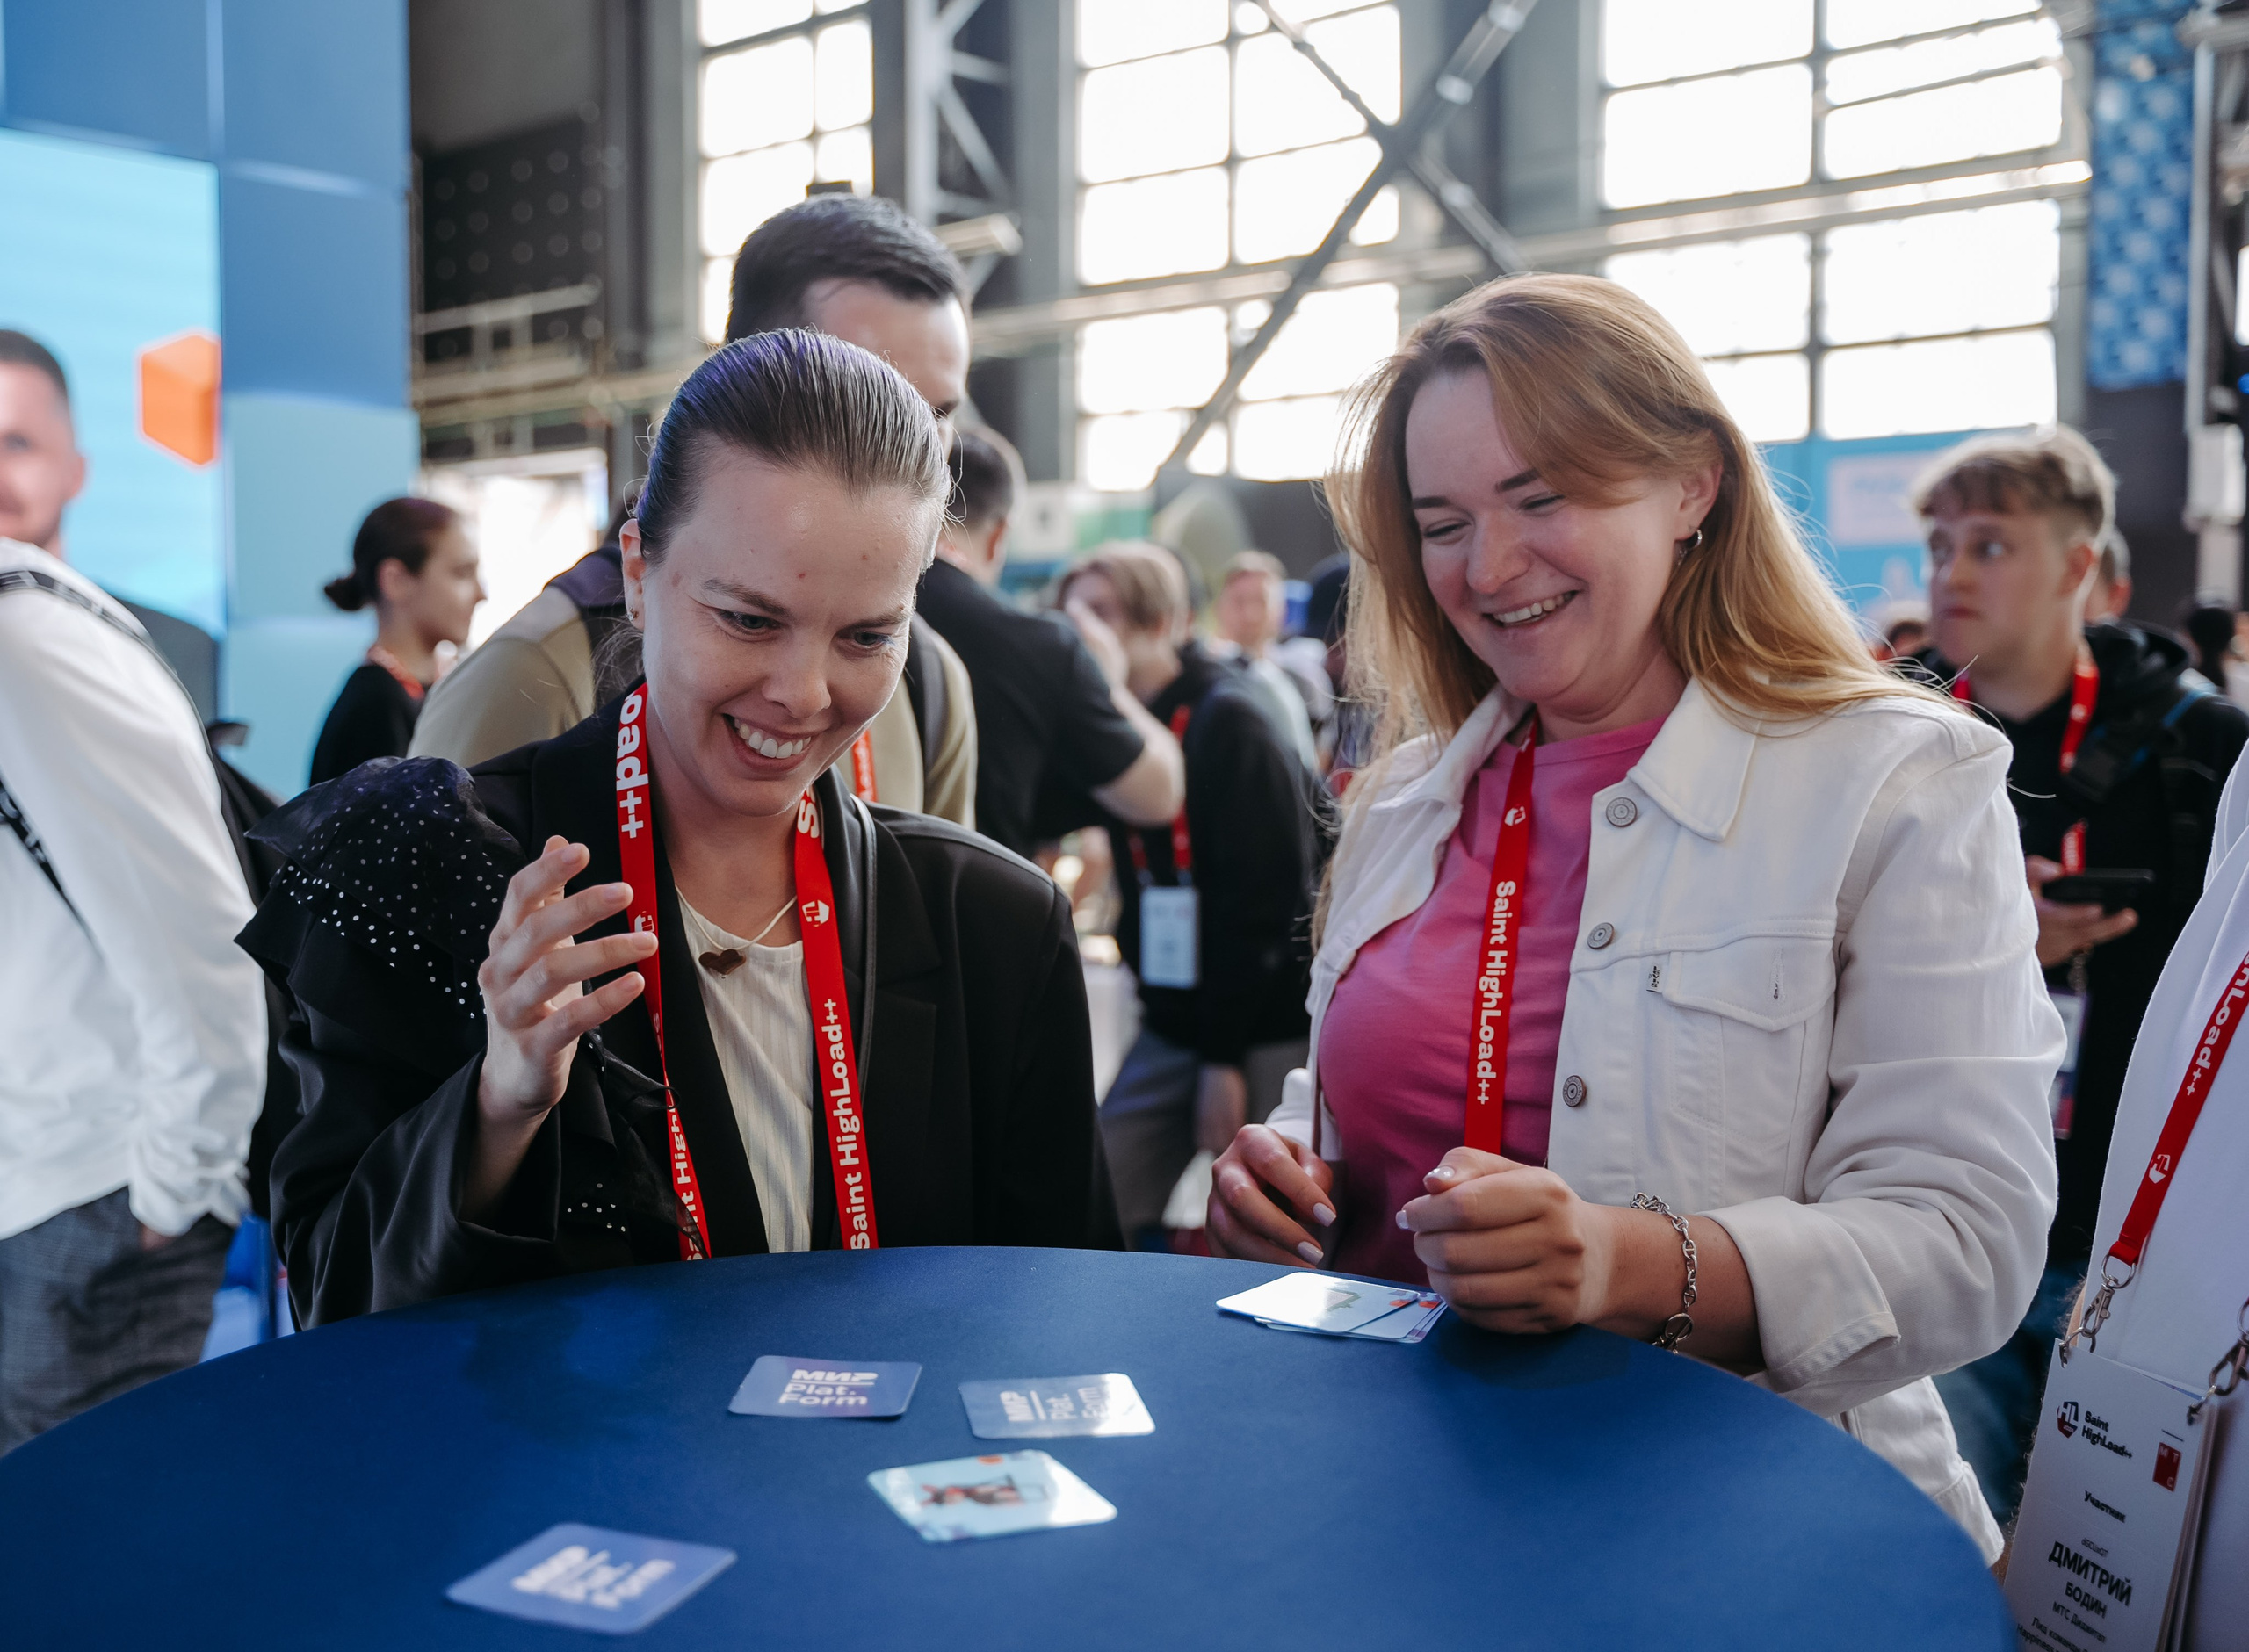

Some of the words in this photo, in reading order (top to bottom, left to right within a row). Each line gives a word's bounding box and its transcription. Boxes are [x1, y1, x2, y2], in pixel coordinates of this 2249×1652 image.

[616, 690, 649, 839] oad++
[1491, 881, 1516, 945] Saint
[1477, 950, 1508, 1105] HighLoad++
[821, 998, 861, 1166] HighLoad++
[845, 1172, 871, 1250] Saint
[778, 1393, 868, 1406] Form
[784, 1382, 857, 1396] Plat.
[2085, 1410, 2109, 1432] Saint
[2081, 1425, 2133, 1460] HighLoad++
[2084, 1490, 2126, 1524] Участник
[2048, 1540, 2133, 1607] ДМИТРИЙ
[2052, 1601, 2071, 1620] МТС
[2065, 1581, 2108, 1619] БОДИН
